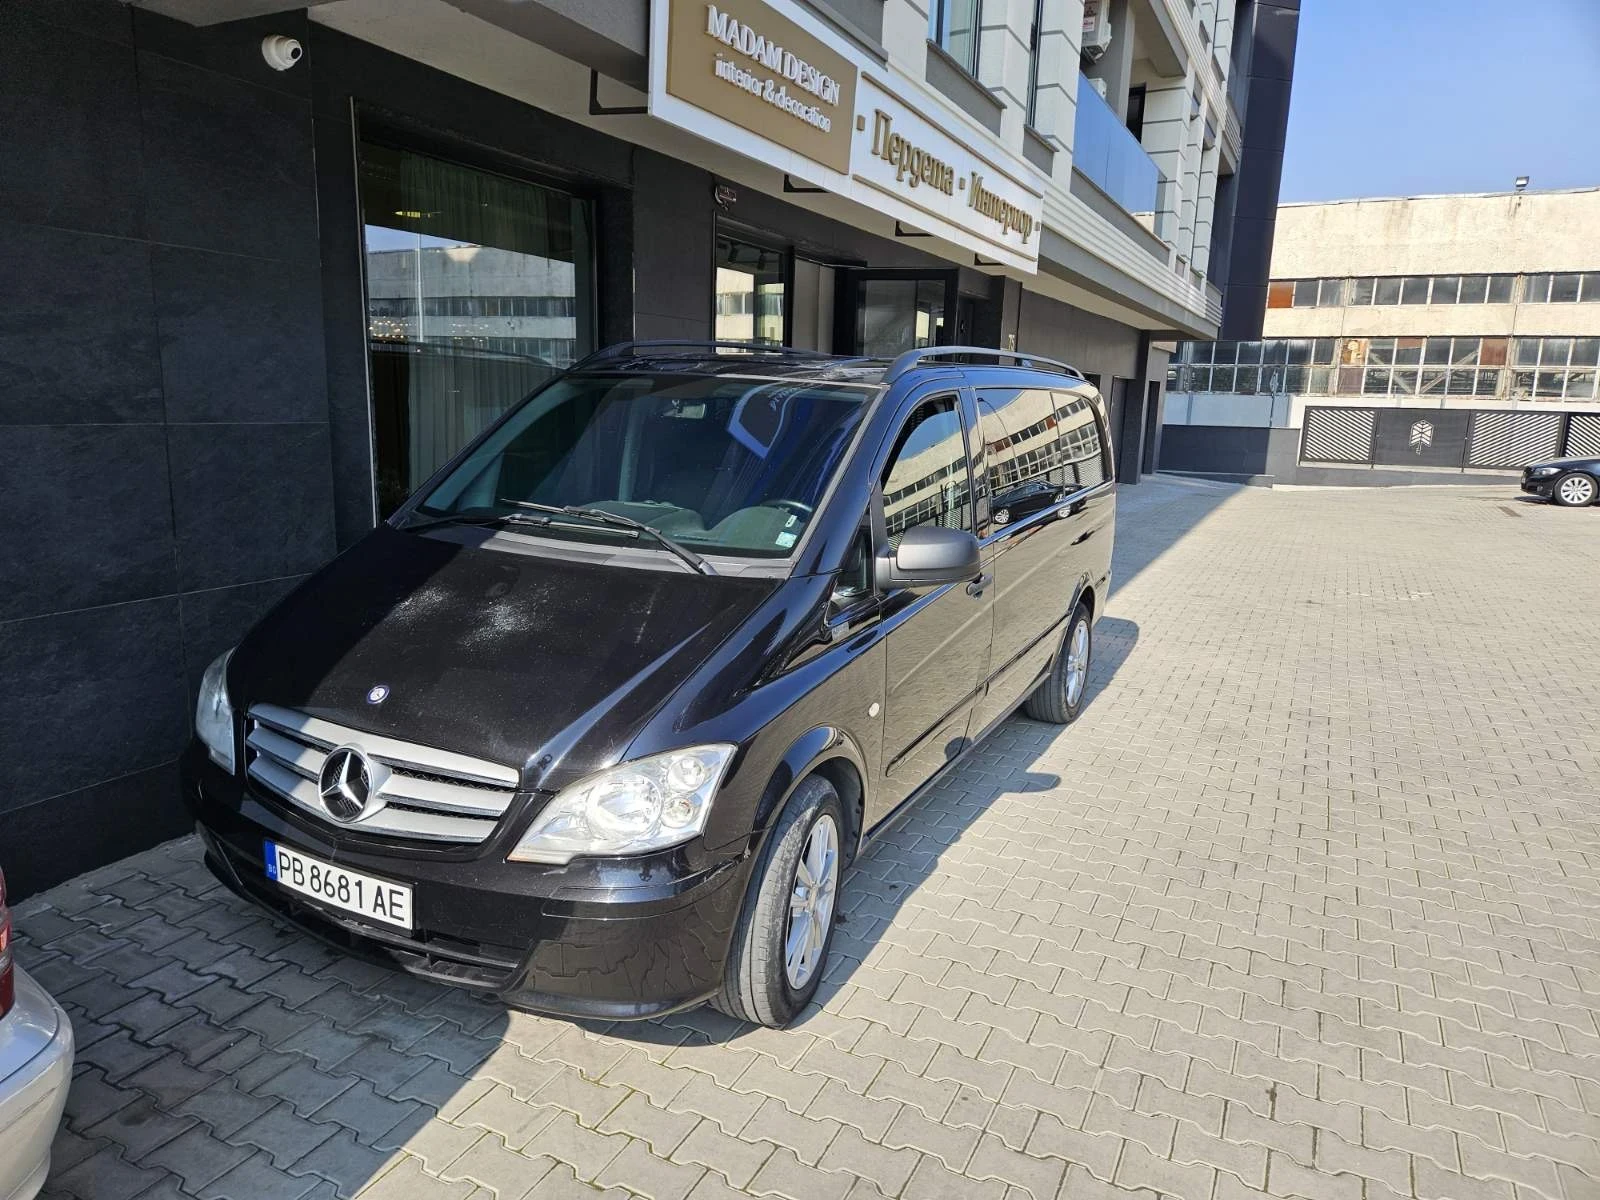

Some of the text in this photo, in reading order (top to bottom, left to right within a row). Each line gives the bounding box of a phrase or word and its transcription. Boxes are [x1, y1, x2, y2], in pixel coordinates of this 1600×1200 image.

[706, 4, 840, 106] MADAM DESIGN
[871, 108, 1033, 244] Пердета Интериор
